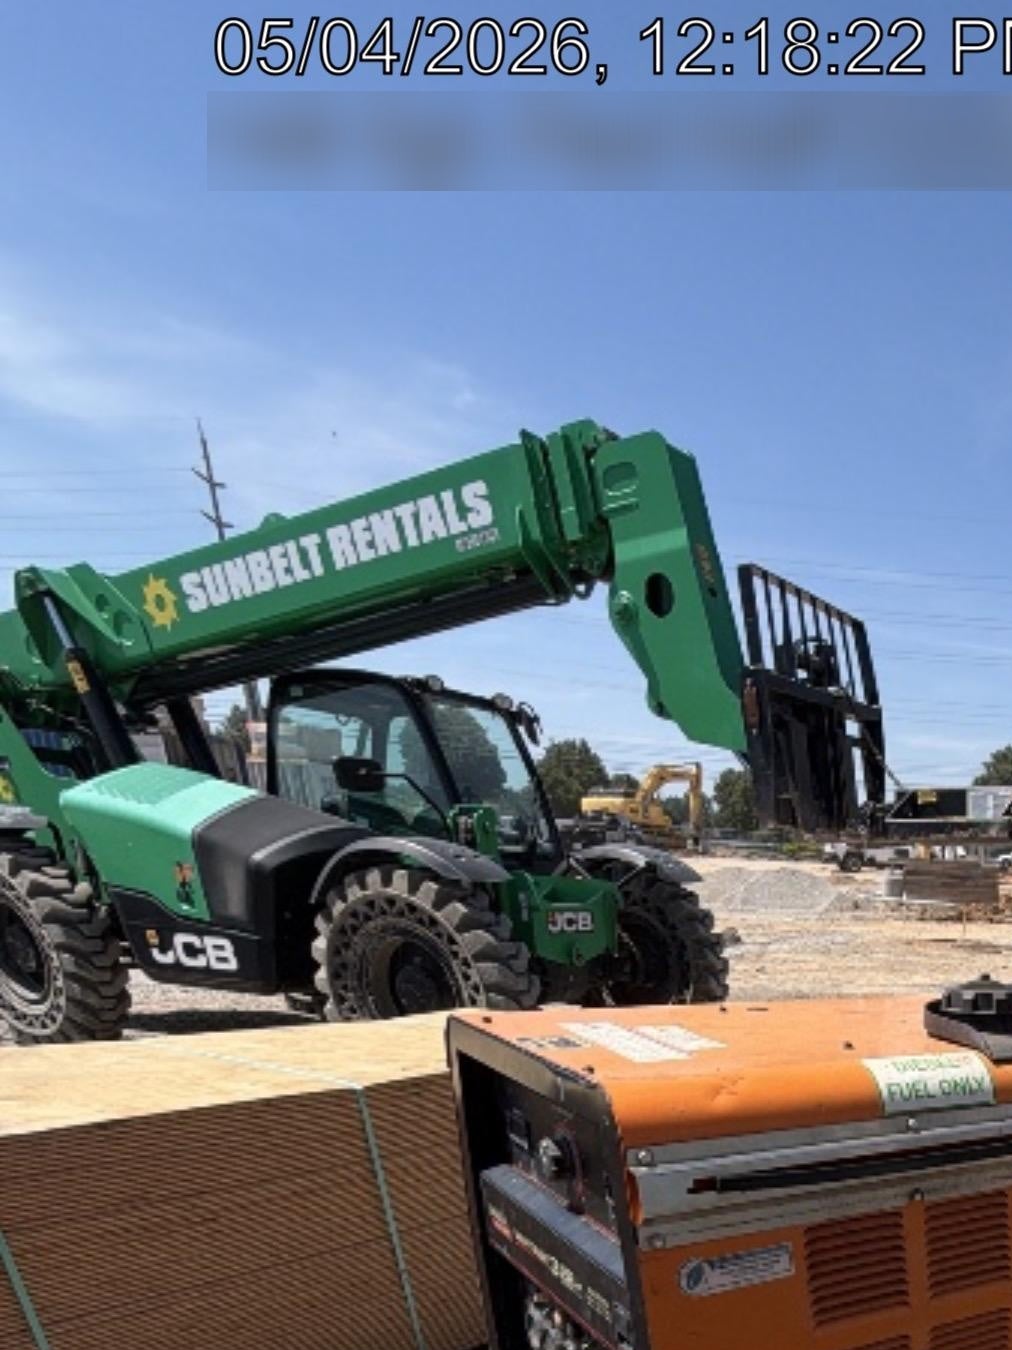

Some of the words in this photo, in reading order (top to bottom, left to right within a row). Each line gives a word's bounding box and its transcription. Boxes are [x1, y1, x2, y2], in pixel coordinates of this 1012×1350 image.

[179, 533, 326, 613] SUNBELT
[326, 480, 494, 571] RENTALS
[549, 911, 593, 934] JCB
[147, 929, 238, 970] JCB
[885, 1080, 937, 1101] FUEL
[938, 1076, 986, 1096] ONLY
